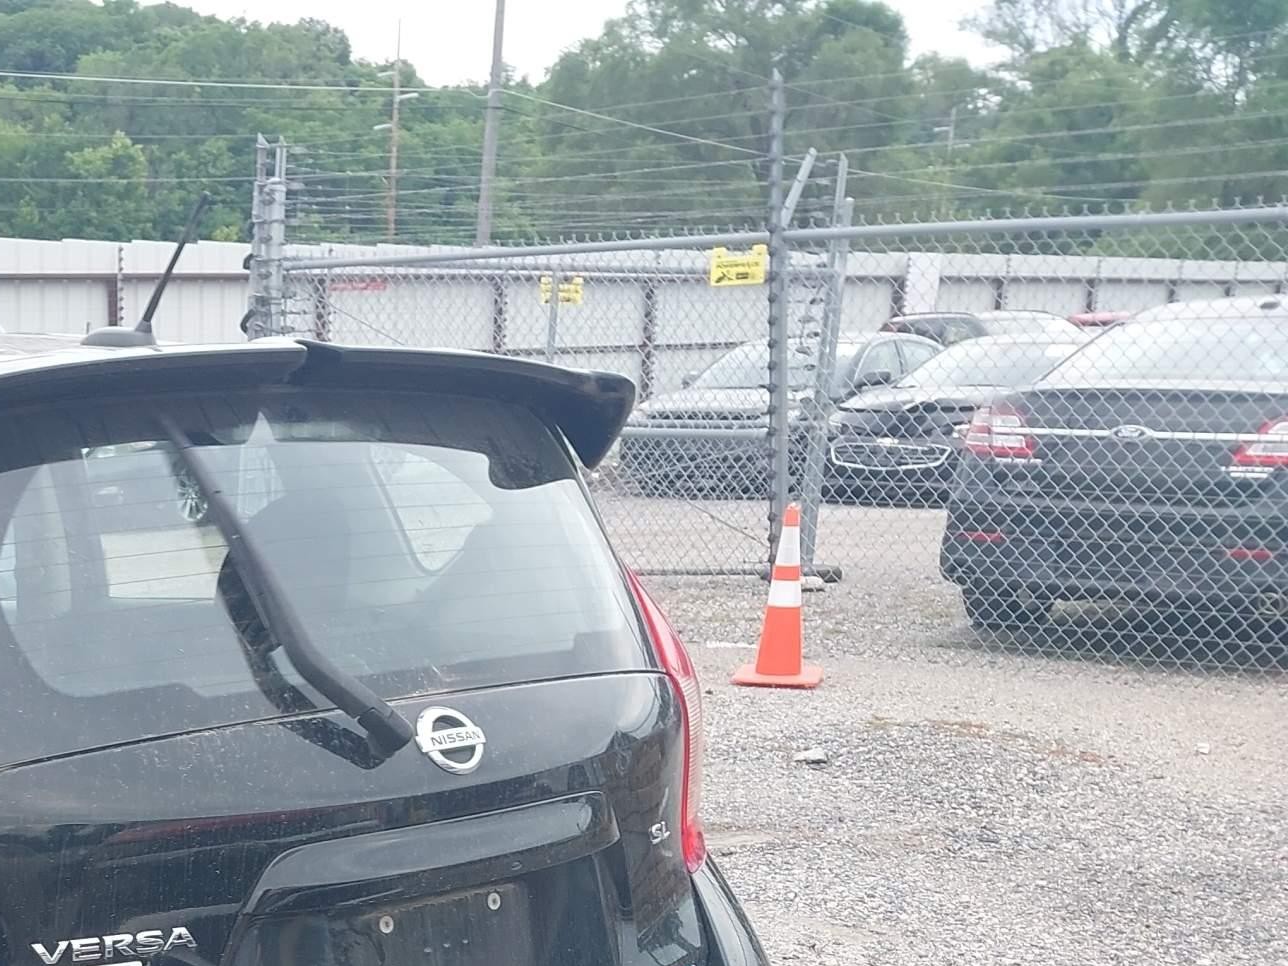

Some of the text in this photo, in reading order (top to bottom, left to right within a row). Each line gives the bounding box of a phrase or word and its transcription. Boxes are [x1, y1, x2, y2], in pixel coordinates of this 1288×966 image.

[430, 730, 481, 746] NISSAN
[650, 821, 671, 844] SL
[30, 926, 198, 965] VERSA
